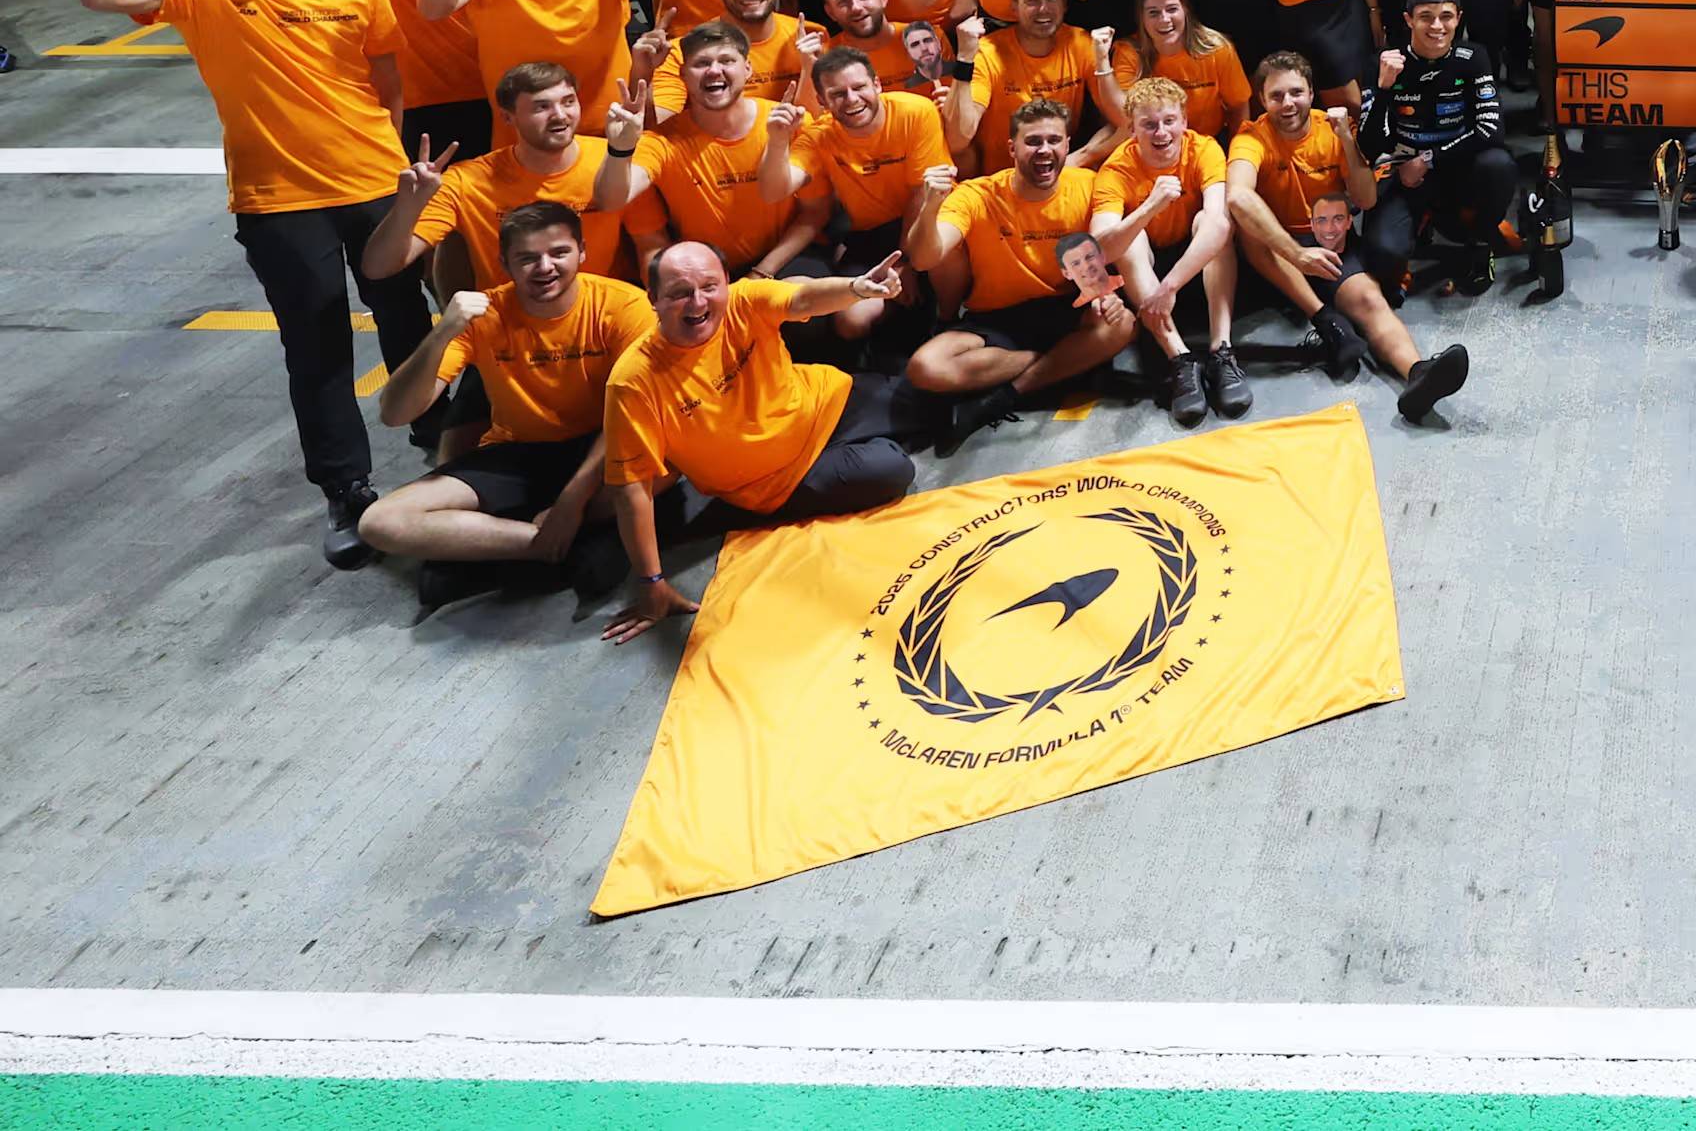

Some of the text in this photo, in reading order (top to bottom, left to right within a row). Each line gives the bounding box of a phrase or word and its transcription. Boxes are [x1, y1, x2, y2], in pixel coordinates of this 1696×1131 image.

[1394, 93, 1421, 101] Android
[1561, 72, 1629, 99] THIS
[1561, 103, 1664, 126] TEAM
[871, 573, 913, 616] 2025
[1146, 485, 1226, 538] CHAMPIONS
[880, 729, 982, 769] McLAREN
[1135, 657, 1194, 705] TEAM
